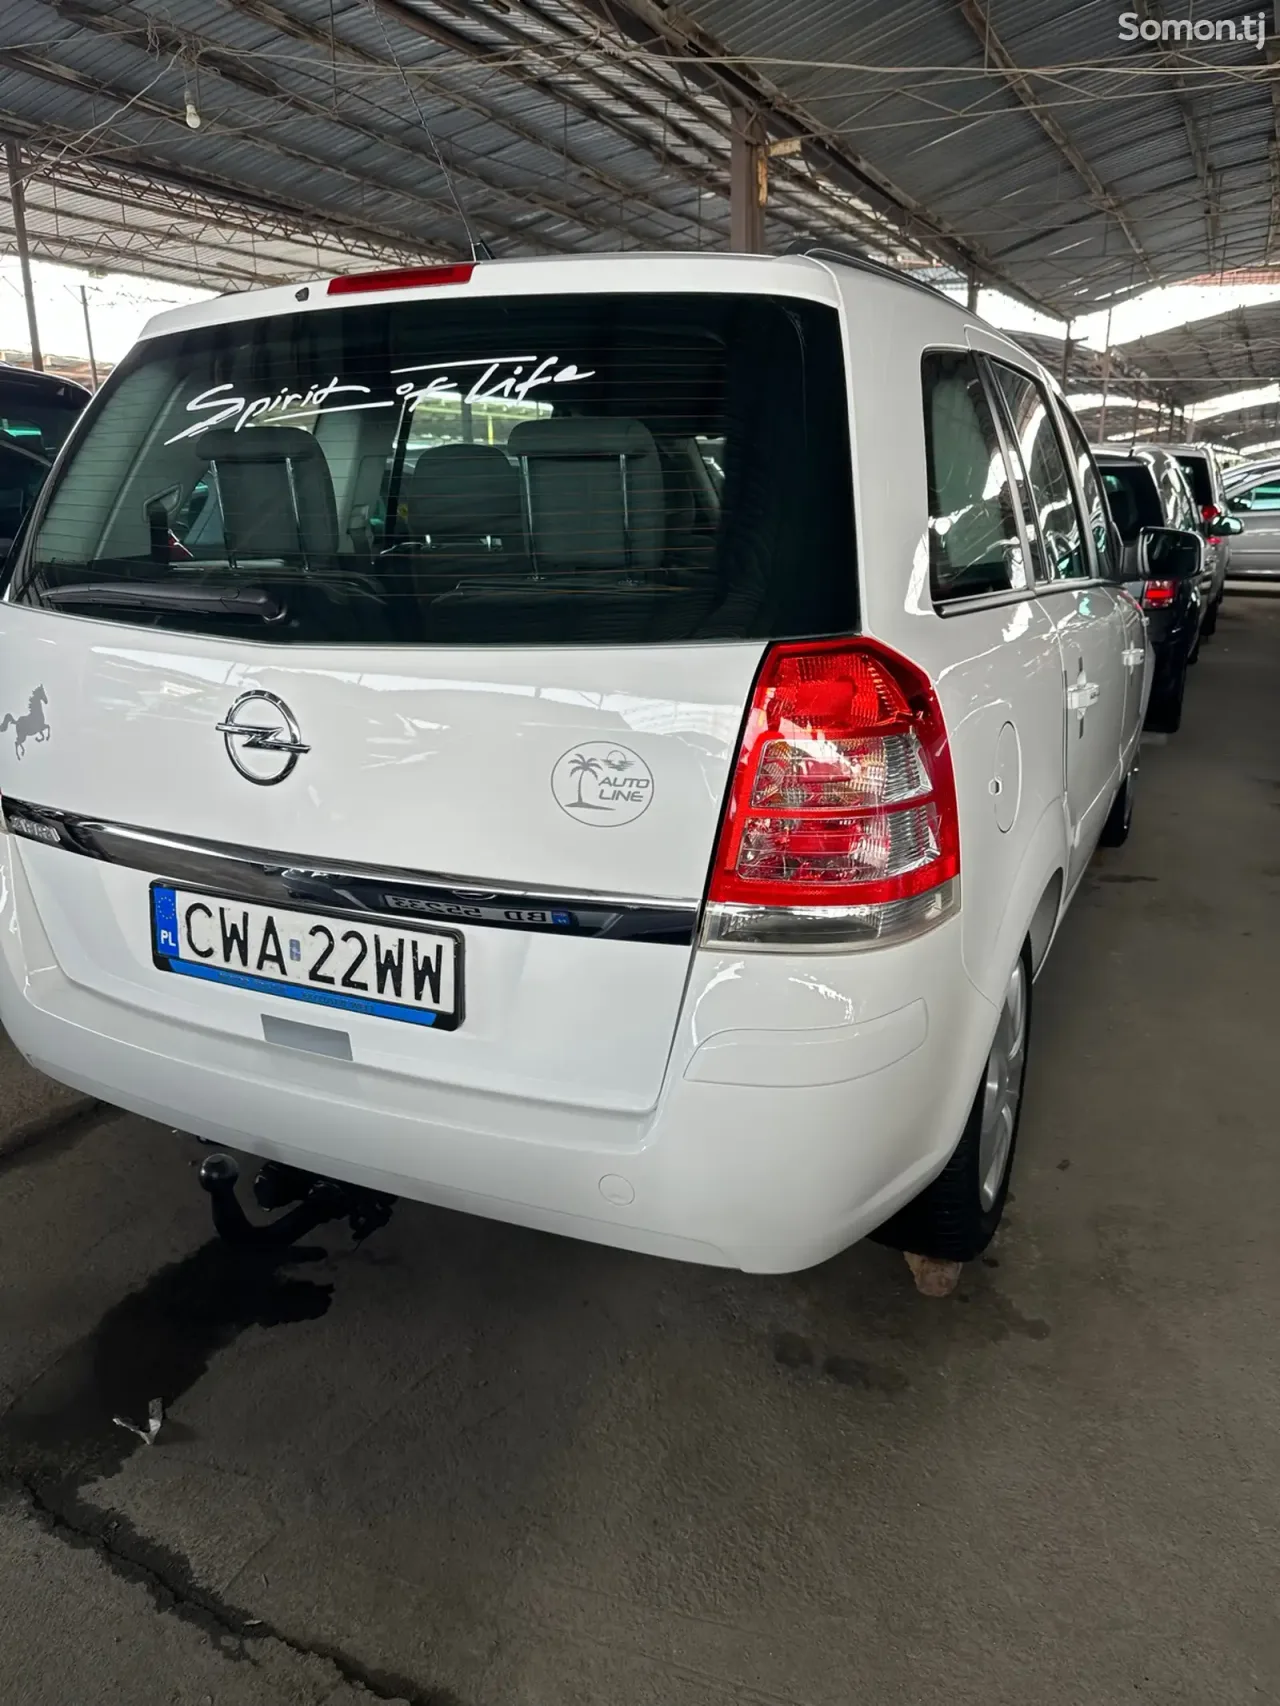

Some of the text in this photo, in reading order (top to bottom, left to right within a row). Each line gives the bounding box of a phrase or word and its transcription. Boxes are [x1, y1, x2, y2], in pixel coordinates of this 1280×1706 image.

[164, 355, 596, 446] Spirit of Life
[598, 776, 650, 789] AUTO
[598, 789, 644, 802] LINE
[160, 930, 176, 947] PL
[185, 902, 443, 1004] CWA 22WW
